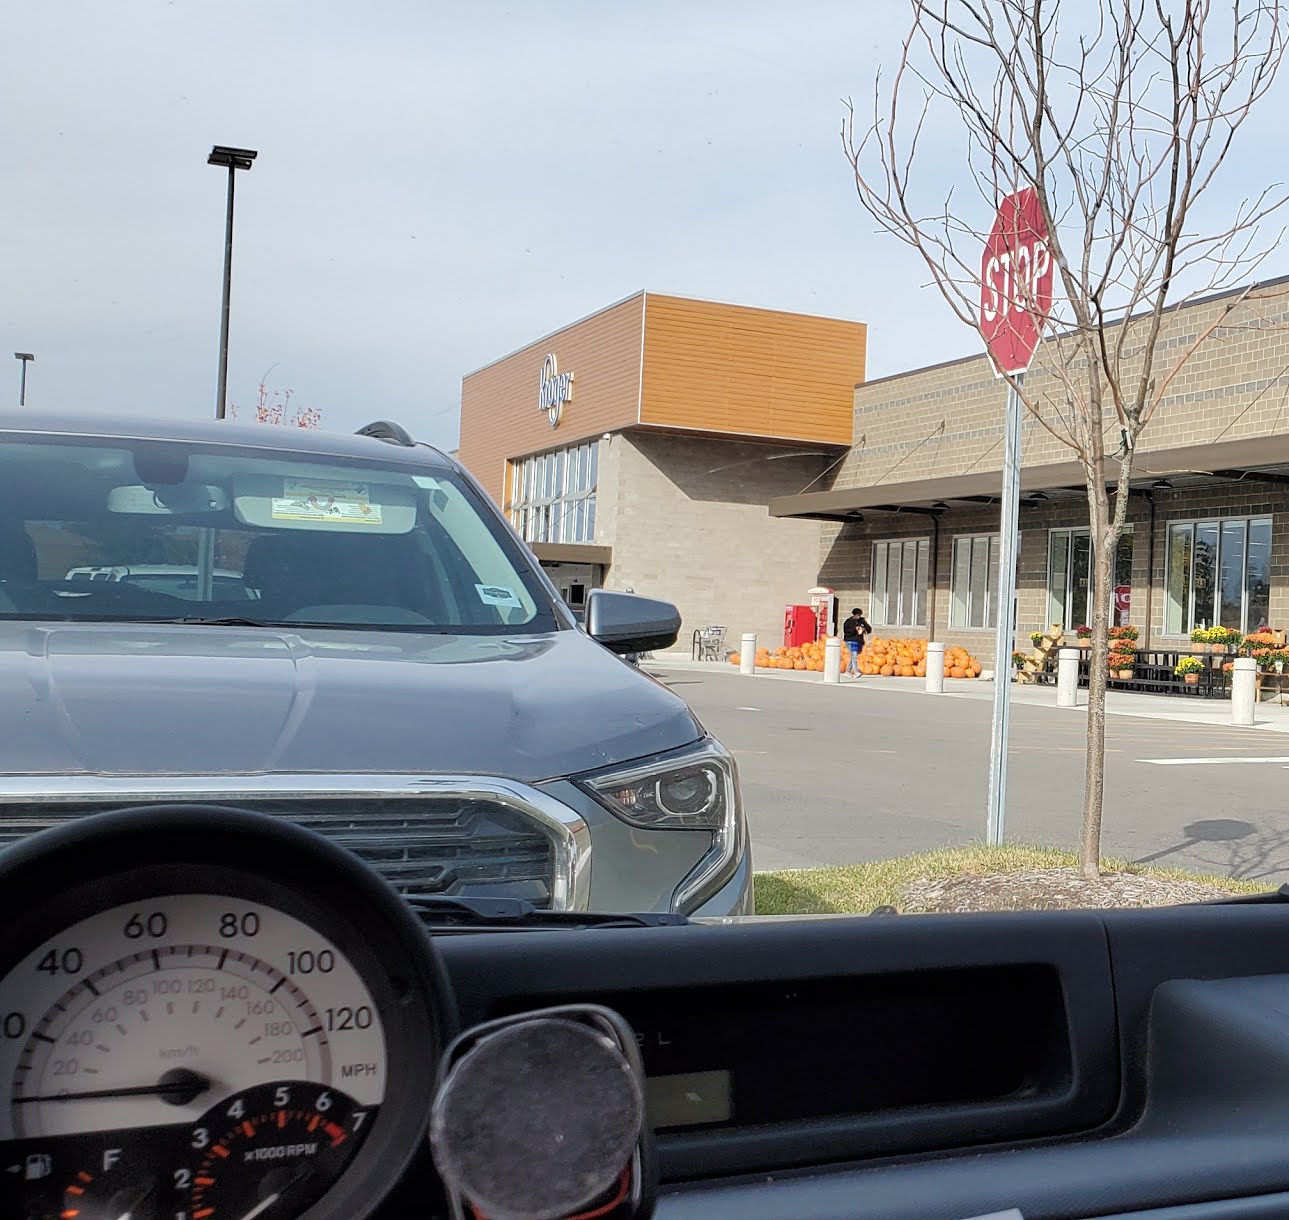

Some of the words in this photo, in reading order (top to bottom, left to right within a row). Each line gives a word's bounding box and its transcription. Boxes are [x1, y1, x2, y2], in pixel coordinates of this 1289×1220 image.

[984, 235, 1050, 321] STOP
[539, 353, 574, 426] Kroger
[125, 912, 168, 939] 60
[219, 912, 260, 938] 80
[37, 947, 83, 975] 40
[288, 949, 335, 975] 100
[152, 979, 183, 995] 100
[188, 978, 216, 994] 120
[220, 985, 249, 1000] 140
[122, 989, 149, 1006] 80
[92, 1006, 118, 1023] 60
[247, 1000, 274, 1015] 160
[325, 1005, 373, 1032] 120
[265, 1021, 292, 1036] 180
[66, 1030, 94, 1047] 40
[271, 1048, 305, 1064] 200
[53, 1058, 79, 1076] 20
[341, 1064, 377, 1078] MPH
[274, 1086, 290, 1106] 5
[315, 1091, 332, 1111] 6
[226, 1099, 244, 1118] 4
[352, 1111, 367, 1131] 7
[191, 1128, 209, 1148] 3
[287, 1142, 318, 1156] RPM
[103, 1148, 122, 1171] F
[174, 1168, 192, 1189] 2
